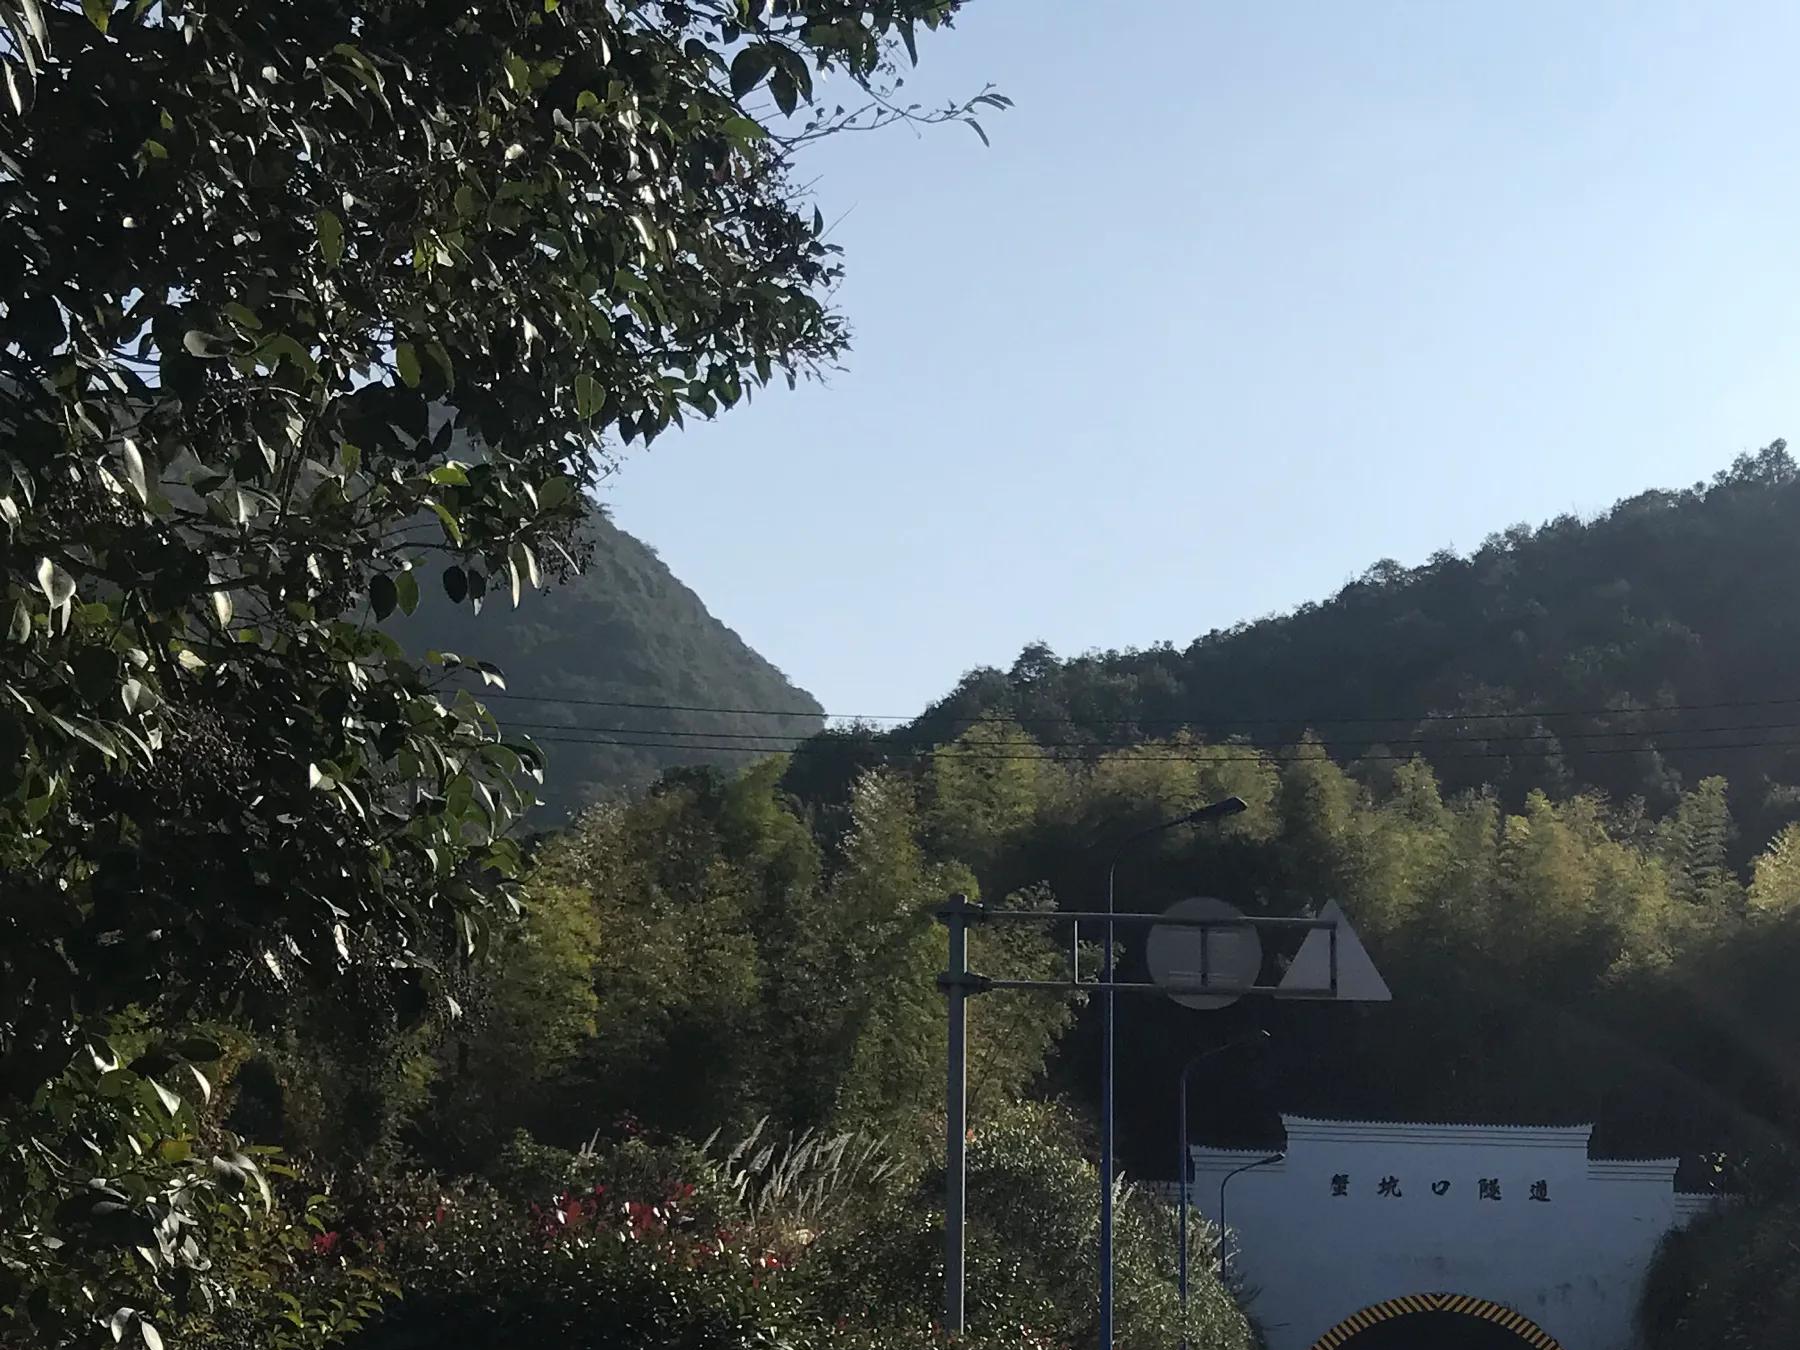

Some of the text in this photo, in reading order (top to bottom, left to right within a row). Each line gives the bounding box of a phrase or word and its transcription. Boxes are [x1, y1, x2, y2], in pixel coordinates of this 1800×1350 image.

[1331, 1173, 1551, 1202] 蟹坑口隧道
